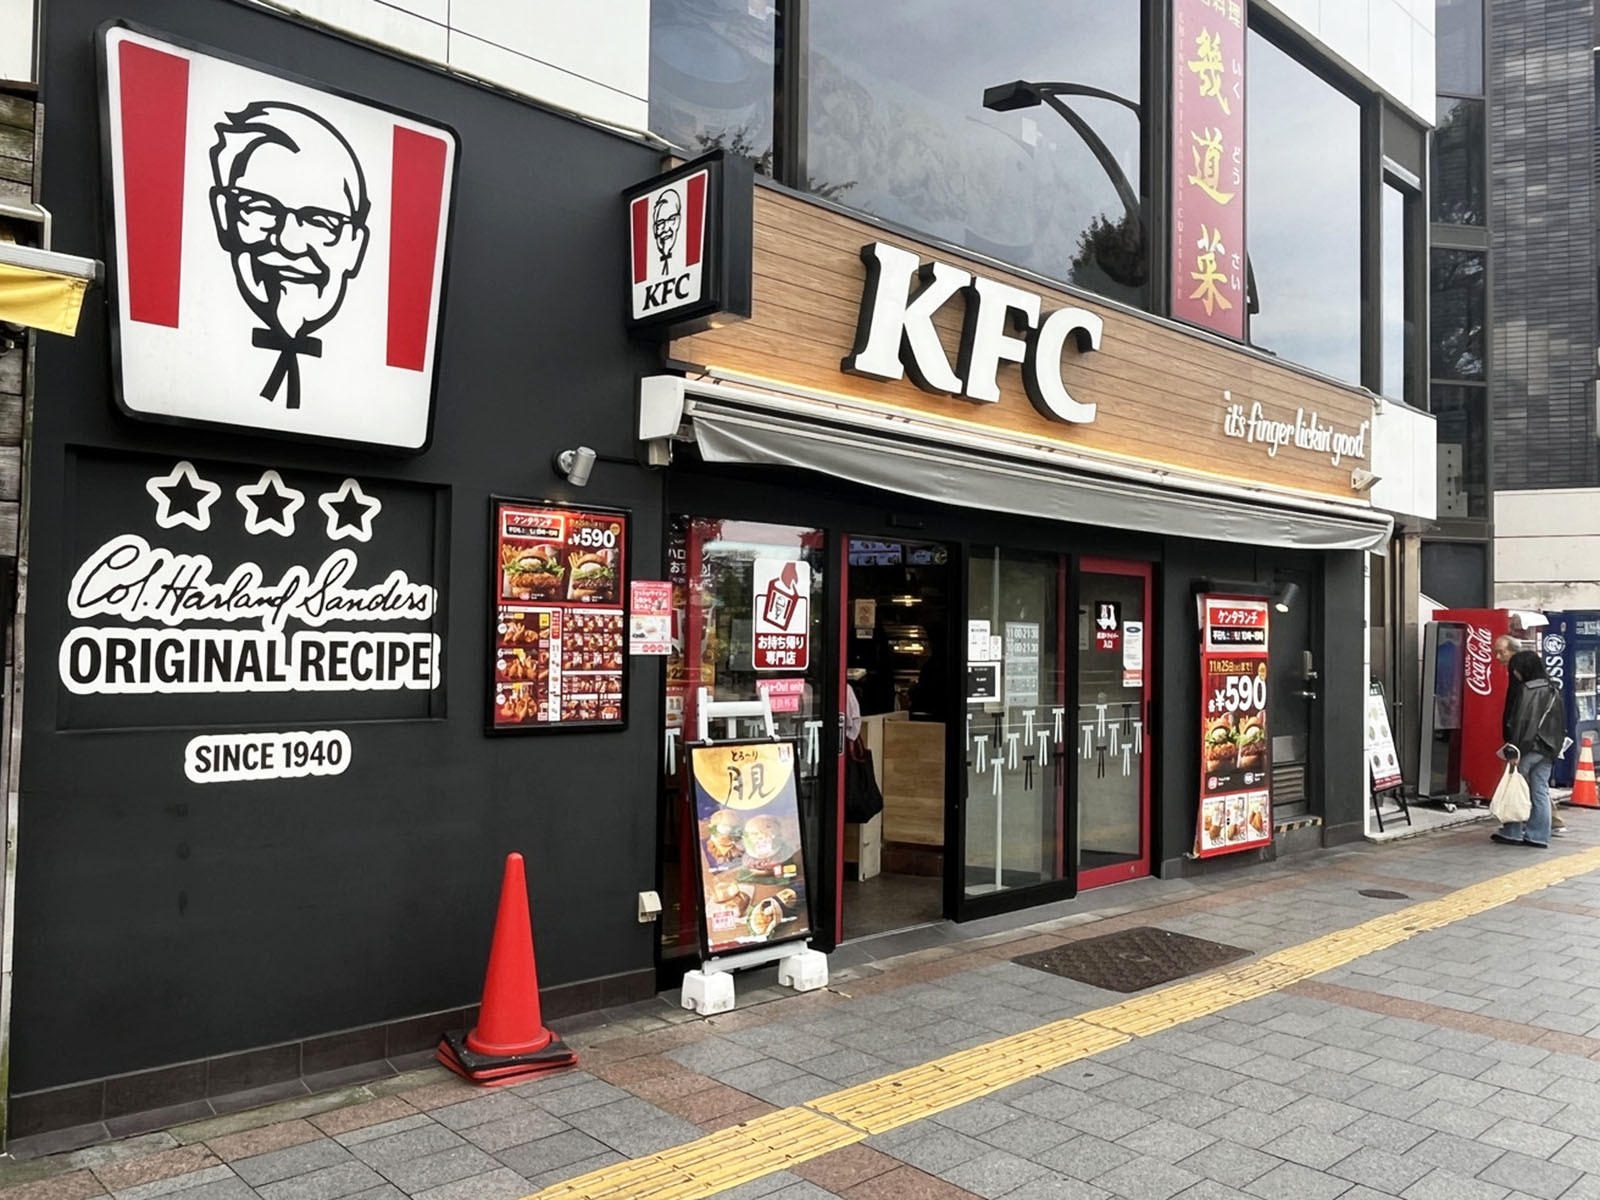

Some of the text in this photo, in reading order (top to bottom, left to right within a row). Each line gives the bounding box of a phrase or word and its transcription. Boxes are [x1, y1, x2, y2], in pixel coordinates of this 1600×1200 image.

[643, 273, 690, 310] KFC
[846, 242, 1104, 425] KFC
[1247, 402, 1294, 457] finger
[77, 545, 428, 625] Col. Harland Sanders
[1218, 610, 1258, 624] ケンタランチ
[69, 637, 431, 684] ORIGINAL RECIPE
[758, 635, 804, 649] お持ち帰り
[765, 651, 796, 665] 専門店
[1466, 624, 1492, 695] Coca-Cola
[194, 739, 343, 773] SINCE 1940
[725, 763, 776, 807] 月見
